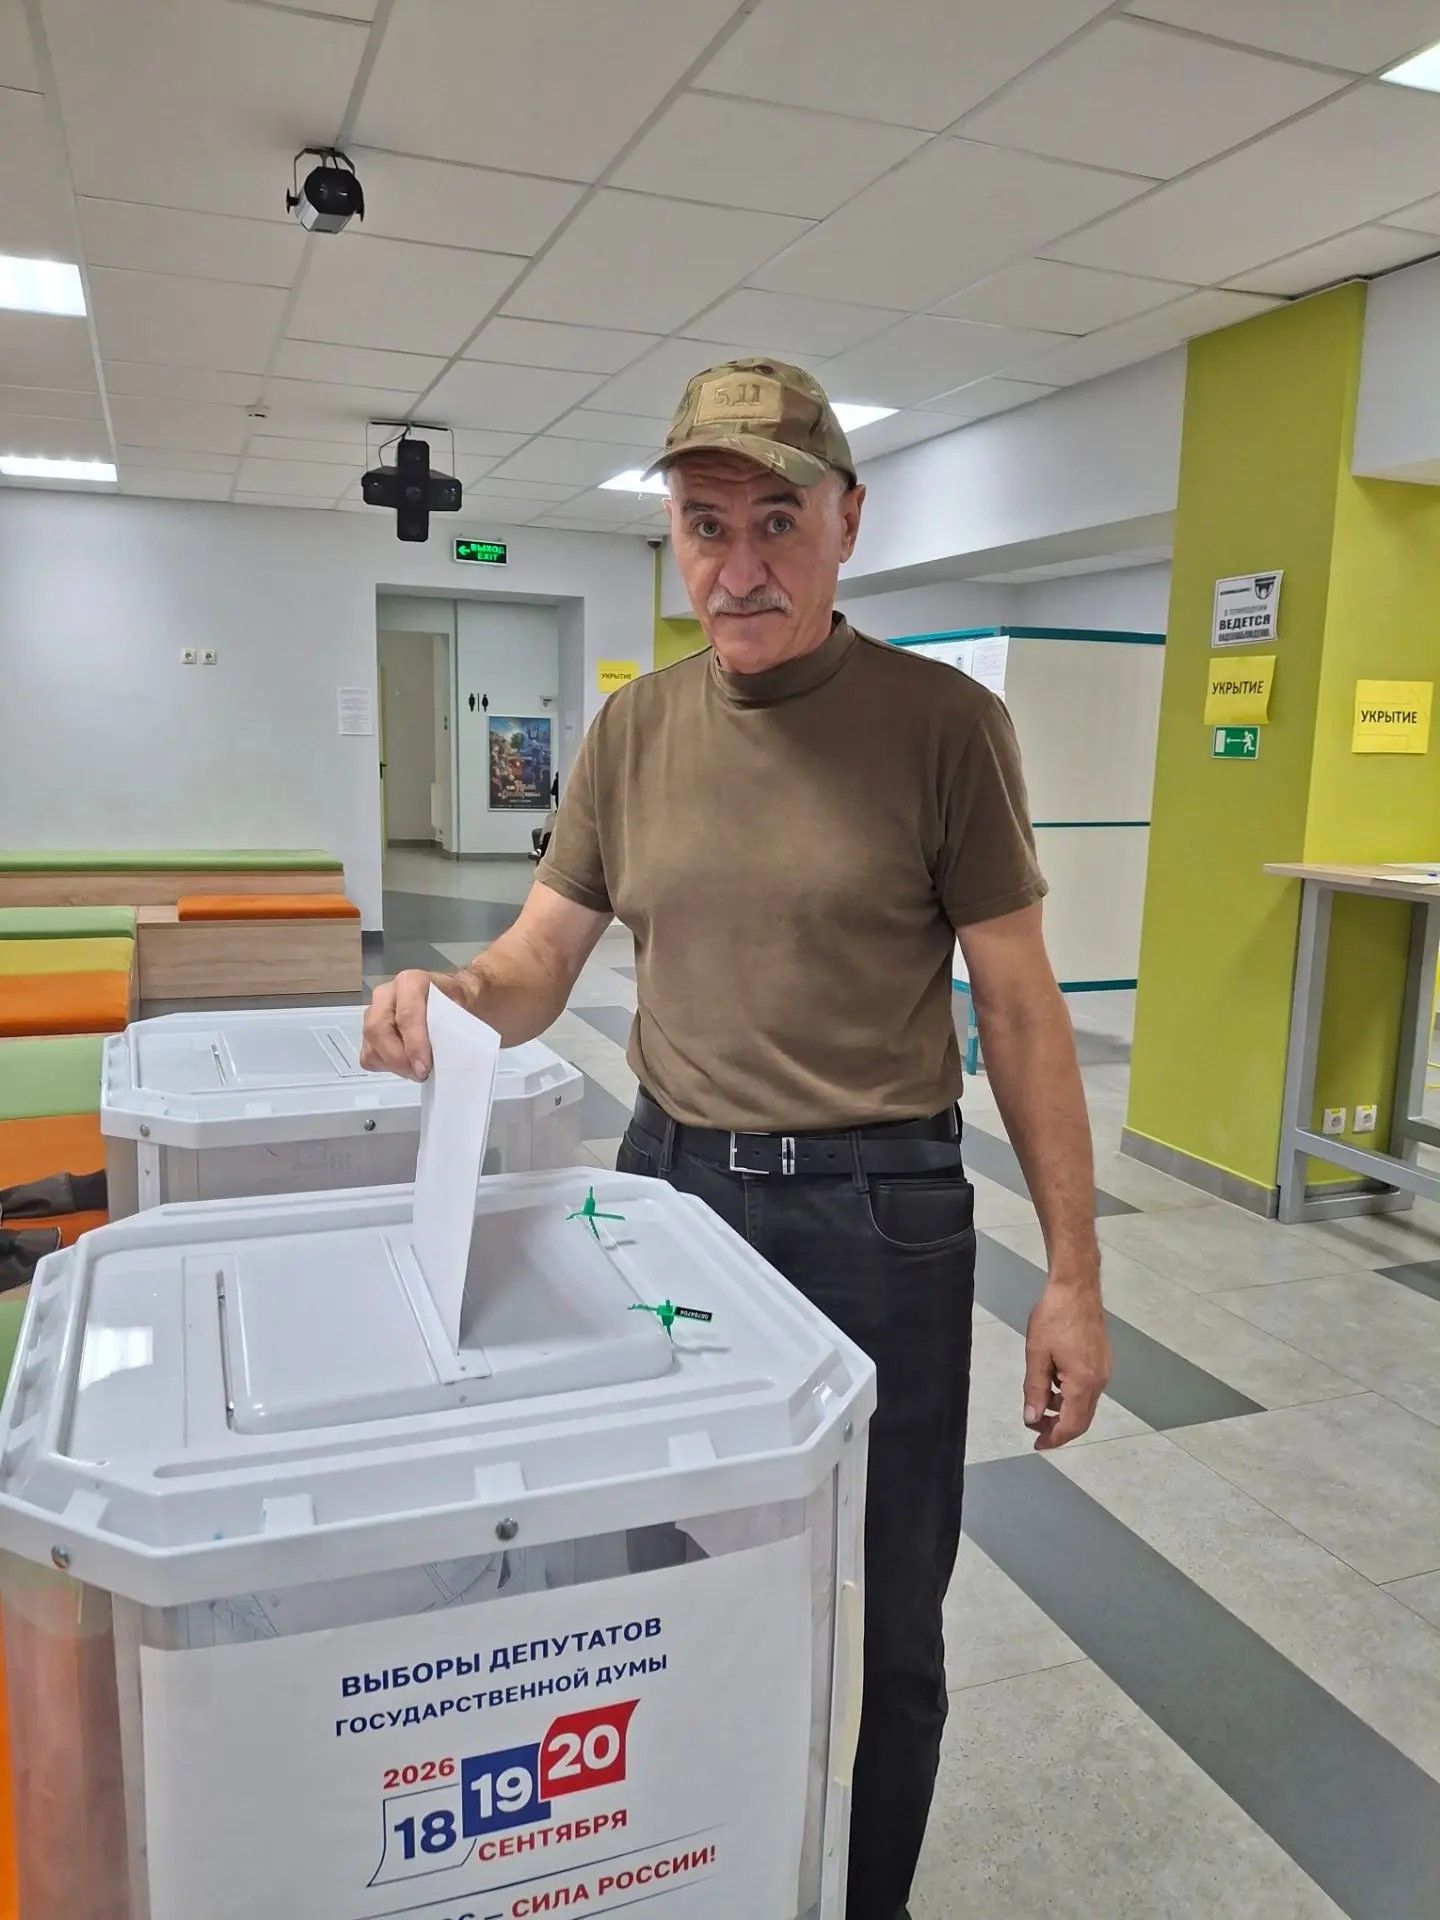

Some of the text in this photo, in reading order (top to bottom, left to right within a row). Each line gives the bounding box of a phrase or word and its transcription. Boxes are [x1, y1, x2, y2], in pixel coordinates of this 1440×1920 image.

[477, 552, 498, 561] EXIT
[1219, 614, 1271, 631] ВЕДЕТСЯ
[1212, 680, 1265, 695] УКРЫТИЕ
[1360, 709, 1418, 724] УКРЫТИЕ
[342, 1617, 662, 1697] ВЫБОРЫ ДЕПУТАТОВ
[336, 1654, 667, 1737] ГОСУДАРСТВЕННОЙ ДУМЫ
[383, 1758, 456, 1790] 2026
[394, 1724, 620, 1860] 18 19 20
[478, 1809, 628, 1861] СЕНТЯБРЯ
[512, 1884, 590, 1918] СИЛА
[598, 1845, 717, 1896] РОССИИ!
